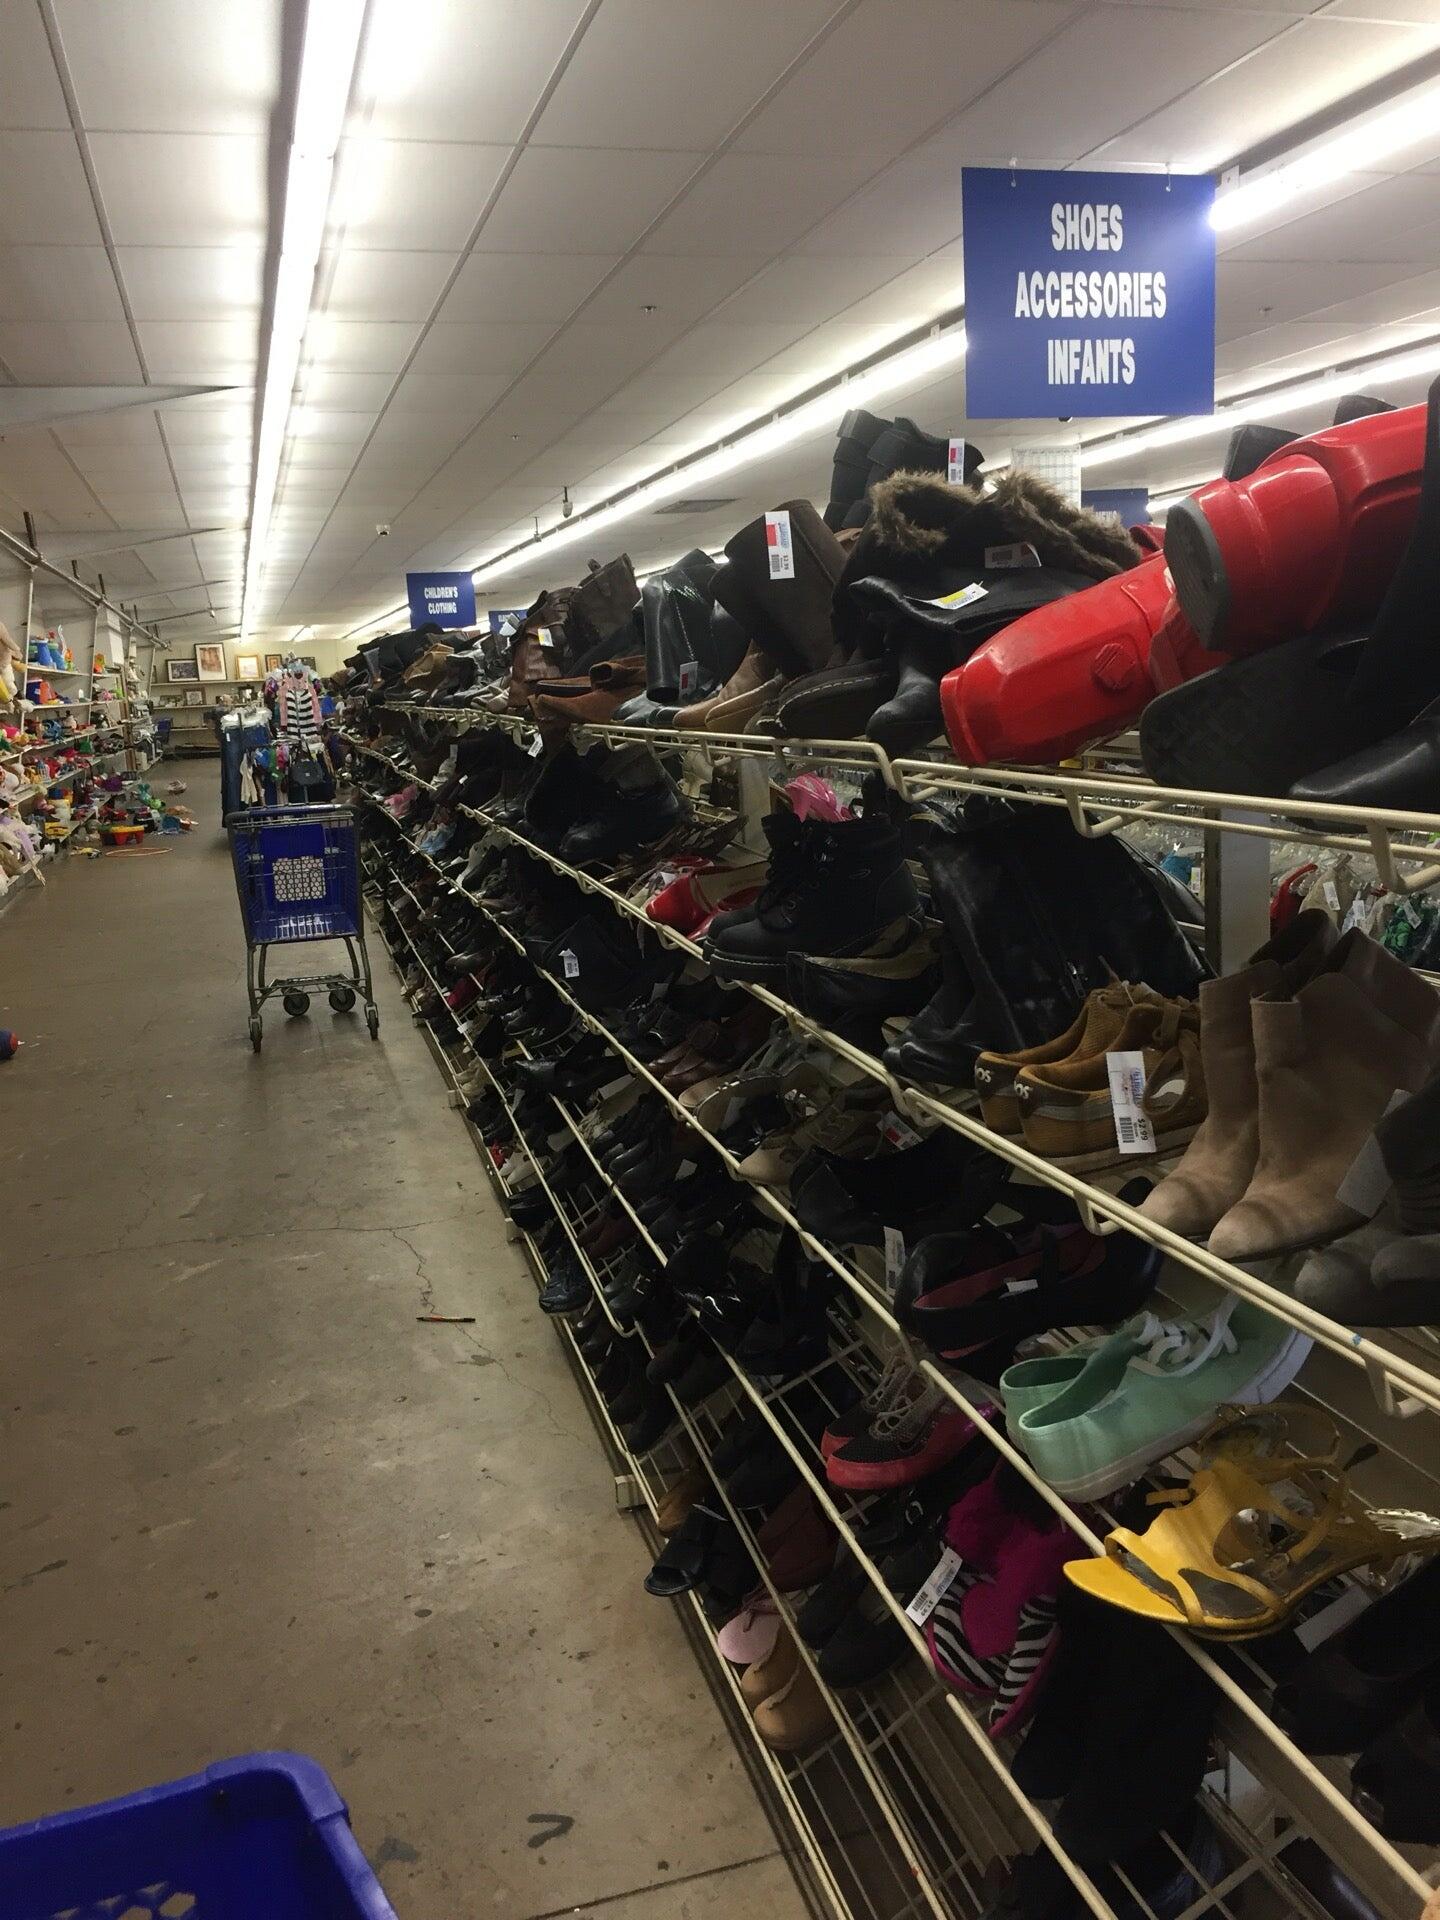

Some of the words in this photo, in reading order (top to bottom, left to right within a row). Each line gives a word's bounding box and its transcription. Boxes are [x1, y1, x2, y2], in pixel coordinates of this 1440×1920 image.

[1051, 202, 1123, 252] SHOES
[1014, 270, 1167, 319] ACCESSORIES
[1047, 338, 1136, 385] INFANTS
[424, 586, 458, 599] CHILDREN'S
[428, 602, 457, 614] CLOTHING
